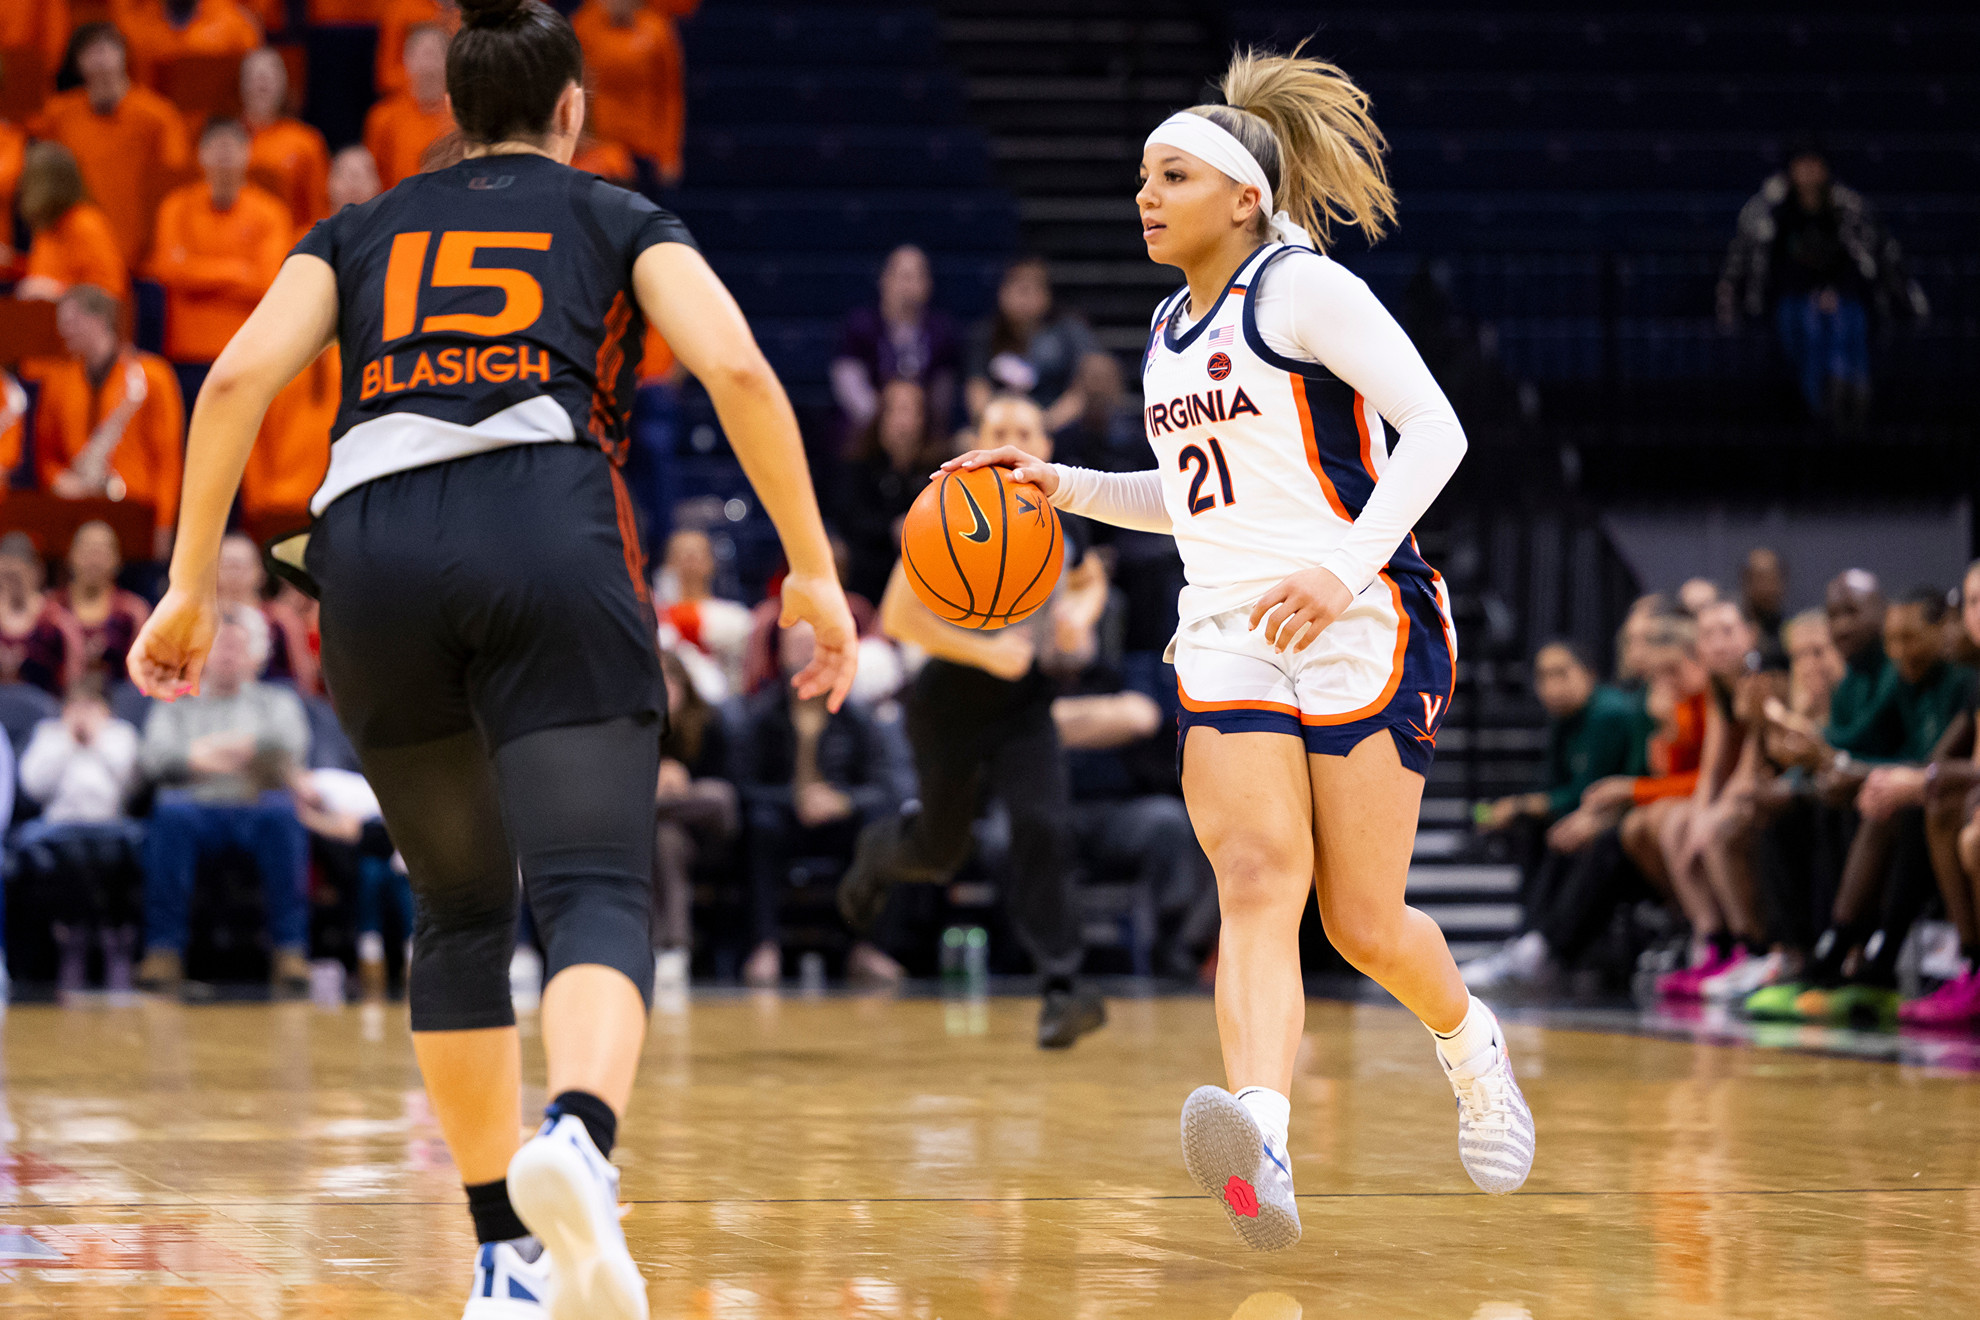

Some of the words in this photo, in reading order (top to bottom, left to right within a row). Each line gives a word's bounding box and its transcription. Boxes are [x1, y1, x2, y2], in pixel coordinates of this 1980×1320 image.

[382, 231, 553, 343] 15
[359, 345, 550, 402] BLASIGH
[1145, 385, 1262, 438] IRGINIA
[1178, 436, 1236, 517] 21
